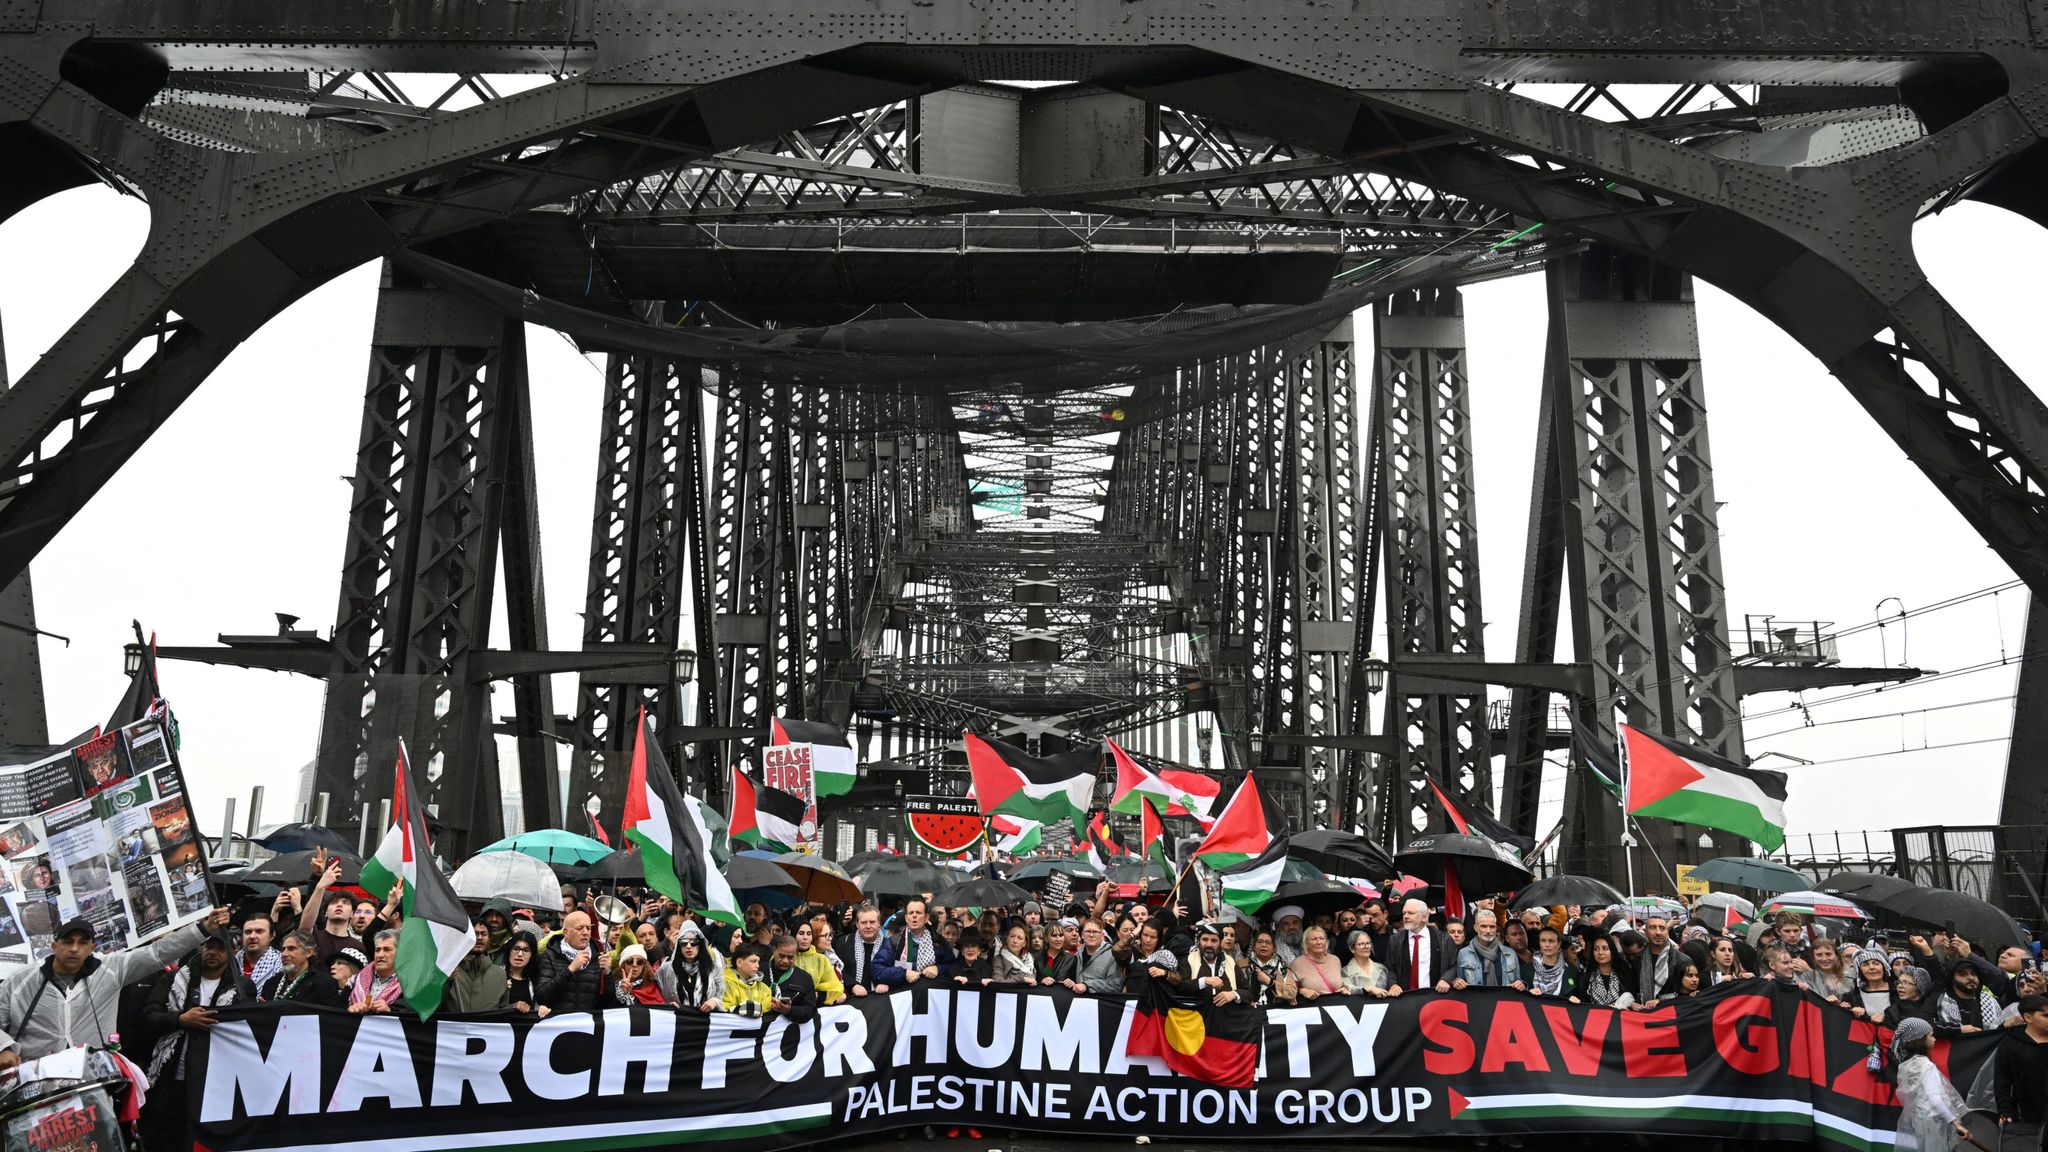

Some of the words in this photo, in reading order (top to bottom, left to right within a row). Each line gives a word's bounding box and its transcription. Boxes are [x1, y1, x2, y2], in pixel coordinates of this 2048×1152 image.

[766, 748, 810, 767] CEASE
[29, 775, 44, 783] STOP
[37, 777, 73, 794] CONSCIENCE
[49, 772, 70, 782] SHAME
[766, 764, 811, 790] FIRE
[906, 802, 931, 810] FREE
[937, 804, 980, 813] PALESTI
[200, 1008, 676, 1122] MARCH
[701, 1004, 875, 1089] FOR
[889, 987, 1389, 1079] HUMATY
[1419, 999, 1688, 1078] SAVE
[844, 1075, 1072, 1124] PALESTINE
[1084, 1085, 1258, 1124] ACTION
[1274, 1088, 1434, 1124] GROUP
[28, 1105, 97, 1144] ARREST
